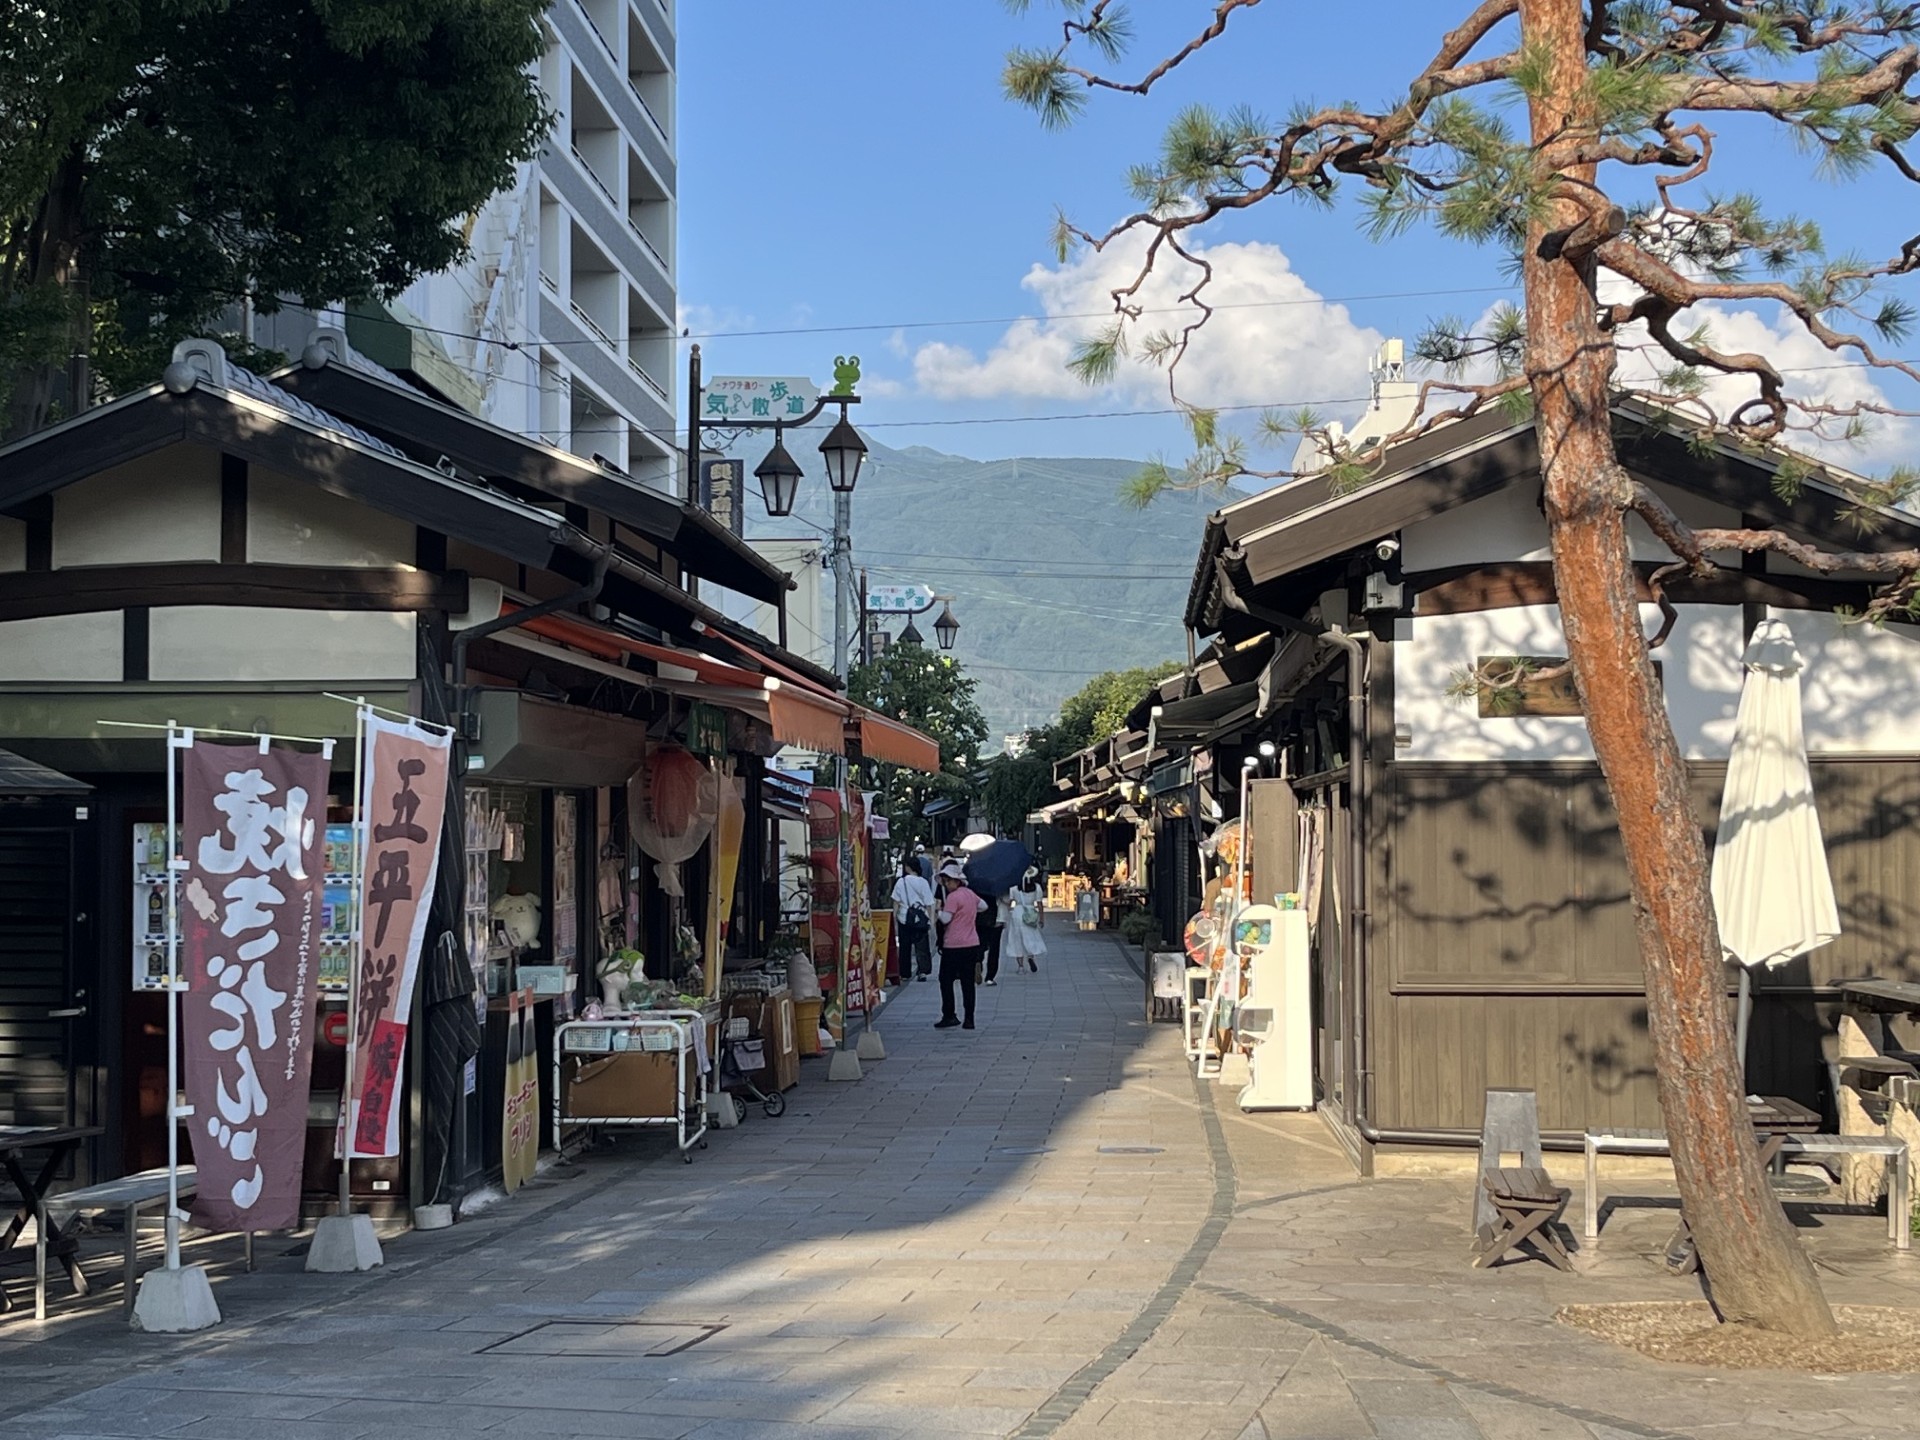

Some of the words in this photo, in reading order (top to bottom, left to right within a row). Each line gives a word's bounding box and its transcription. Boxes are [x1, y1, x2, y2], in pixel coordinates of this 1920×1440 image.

[358, 759, 428, 1049] 五平餅
[361, 1032, 397, 1145] 味自慢
